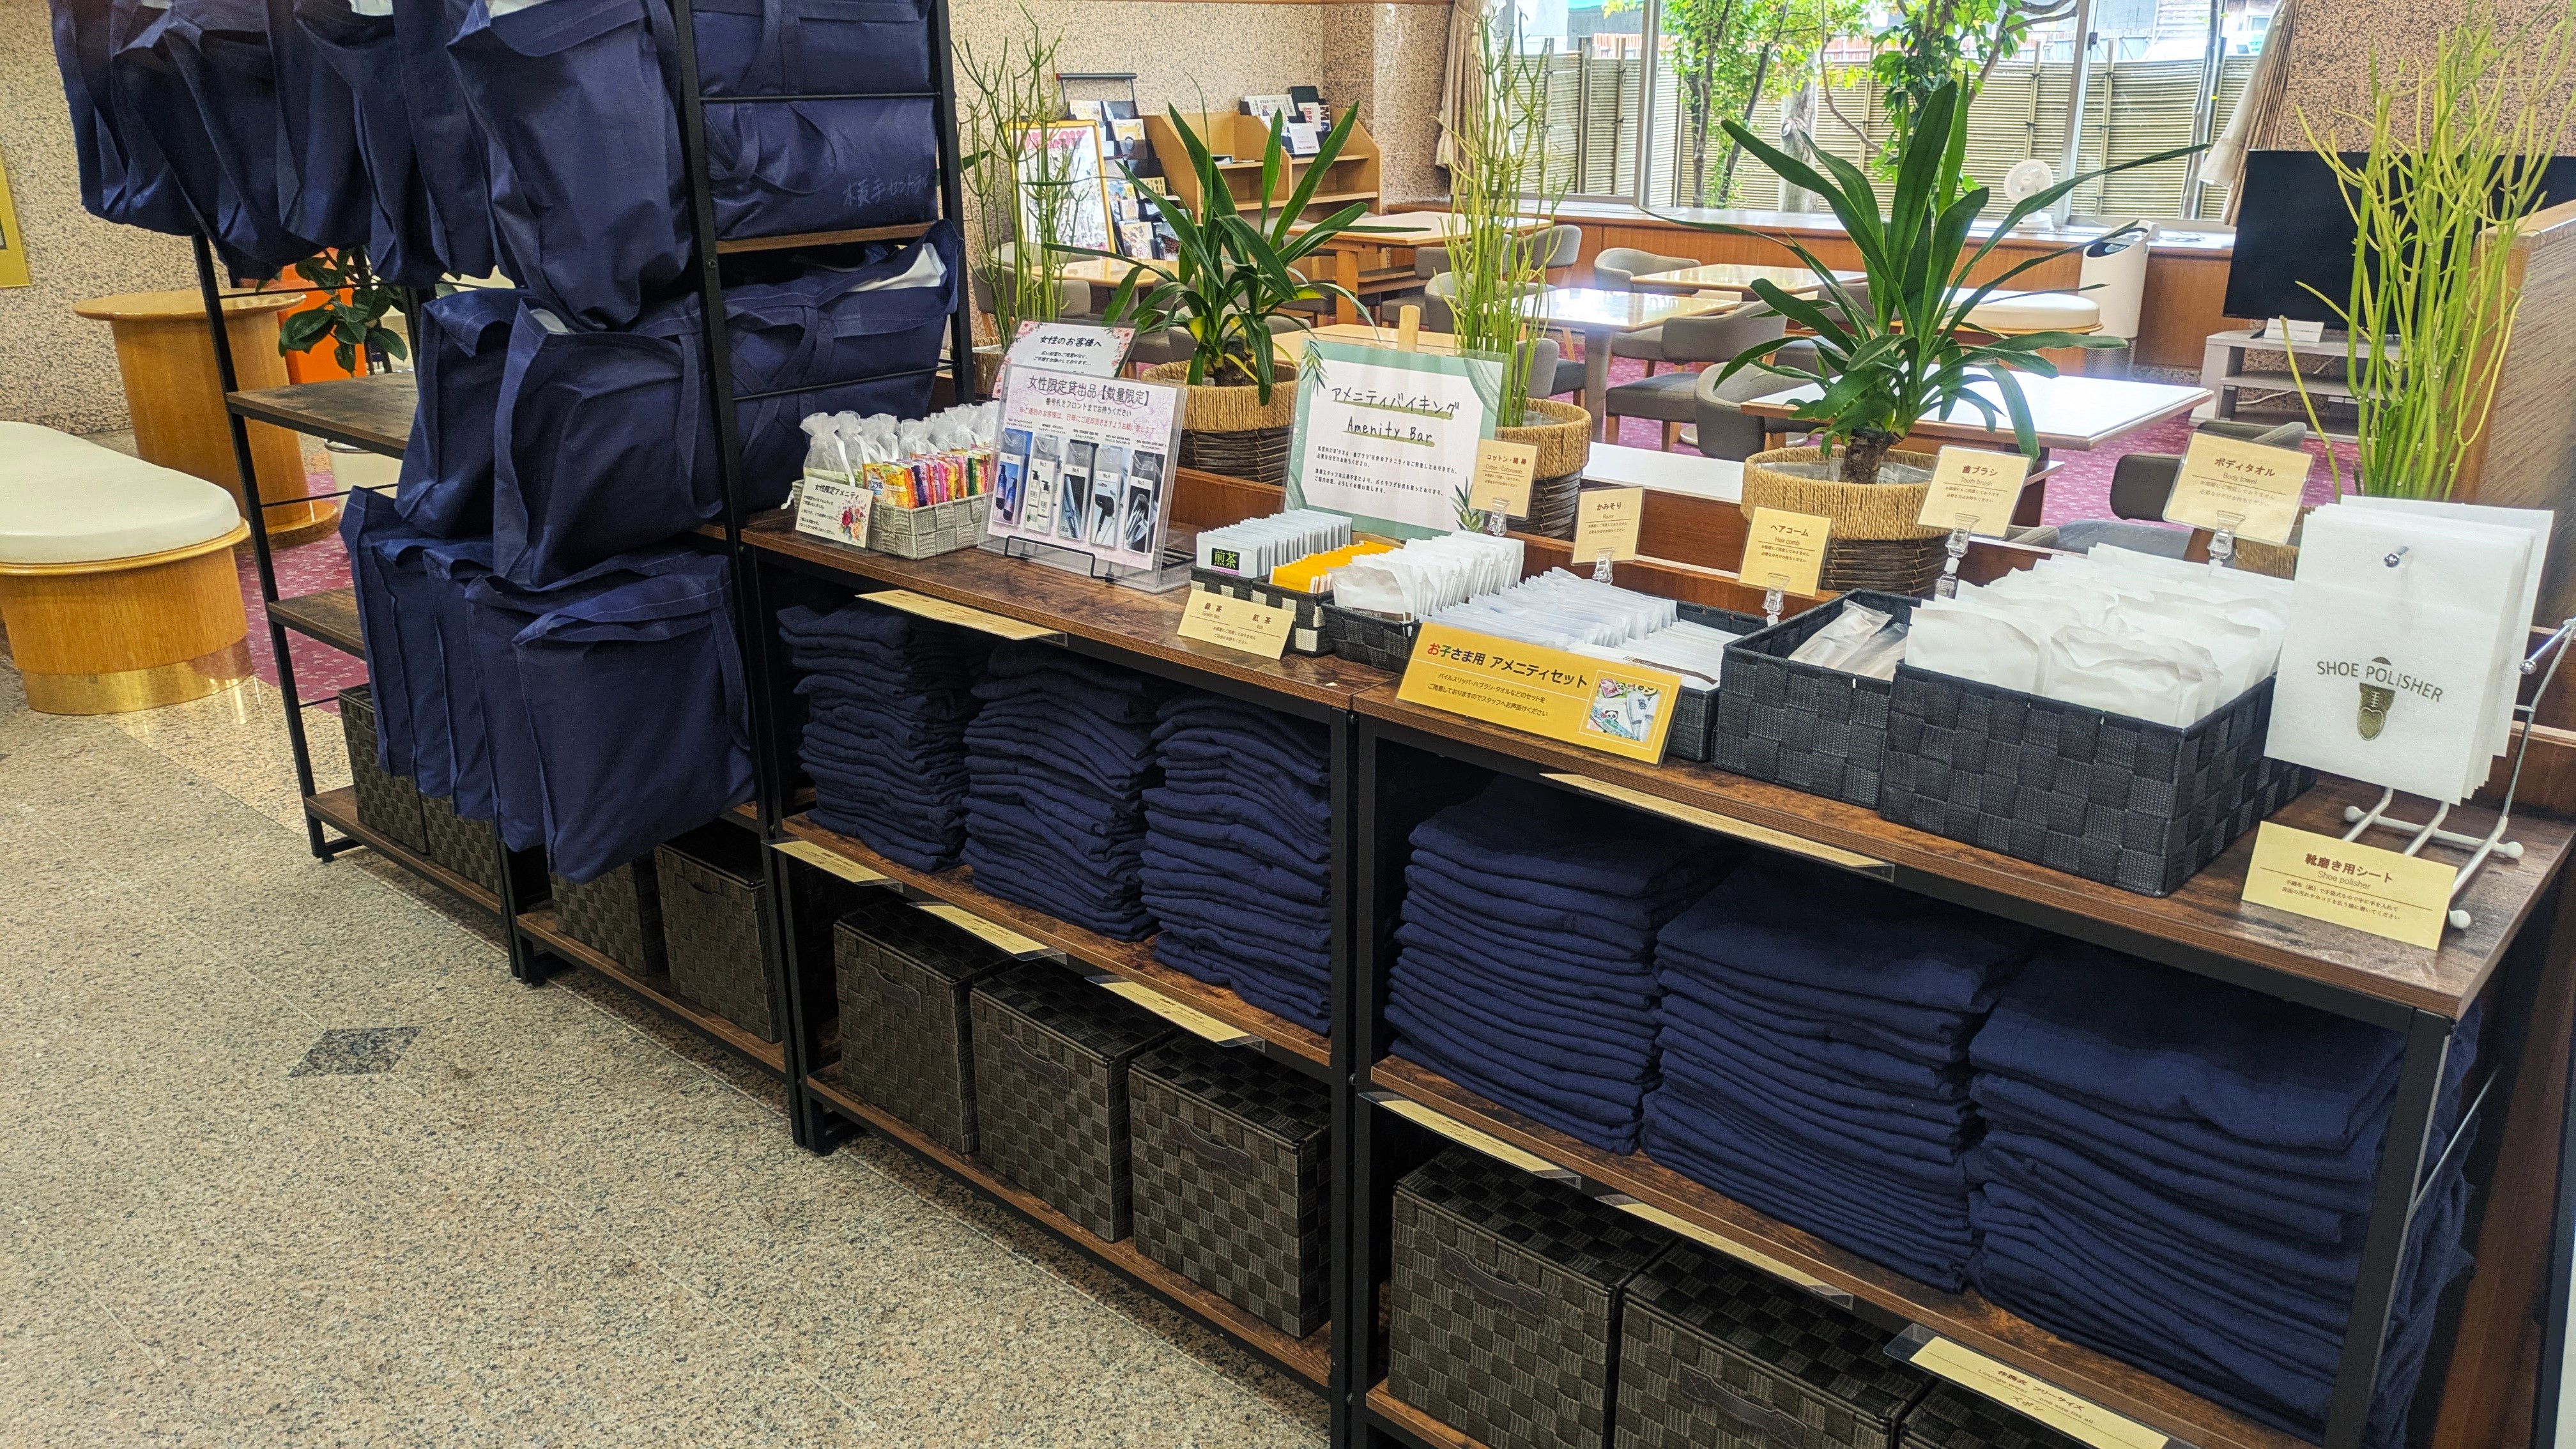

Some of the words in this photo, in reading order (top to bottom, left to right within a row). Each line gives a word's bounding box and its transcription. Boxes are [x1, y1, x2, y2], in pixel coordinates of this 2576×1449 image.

[1040, 335, 1102, 347] 女性のお客様へ
[1027, 376, 1151, 406] 女性限定貸出品【数量限定】
[1331, 387, 1459, 417] アメニティバイキング
[1347, 417, 1400, 438] Amenity
[1409, 426, 1432, 443] Bar
[1962, 465, 1998, 477] 歯ブラシ
[2214, 457, 2276, 477] ボディタオル
[2223, 472, 2239, 482] Body
[2240, 477, 2258, 485] towel
[815, 484, 859, 499] 女性限定アメニティ
[1597, 502, 1621, 510] かみそり
[1770, 525, 1809, 537] ヘアコーム
[1214, 550, 1238, 569] 煎茶
[1427, 642, 1486, 666] お子さま用
[1489, 656, 1588, 689] アメニティセット
[2317, 661, 2359, 678] SHOE
[2366, 666, 2442, 703] POLISHER
[2304, 852, 2393, 884] 靴磨き用シート
[2317, 870, 2338, 882] Shoe
[2339, 876, 2371, 891] polisher
[1978, 1368, 2007, 1384] Lounge
[2008, 1383, 2028, 1394] wear
[2039, 1397, 2053, 1406] one
[2055, 1404, 2069, 1413] size
[2070, 1411, 2082, 1419] fits
[1997, 1370, 2028, 1386] 作務衣
[2032, 1386, 2085, 1411] フリーサイズ
[2010, 1395, 2043, 1411] ズボン
